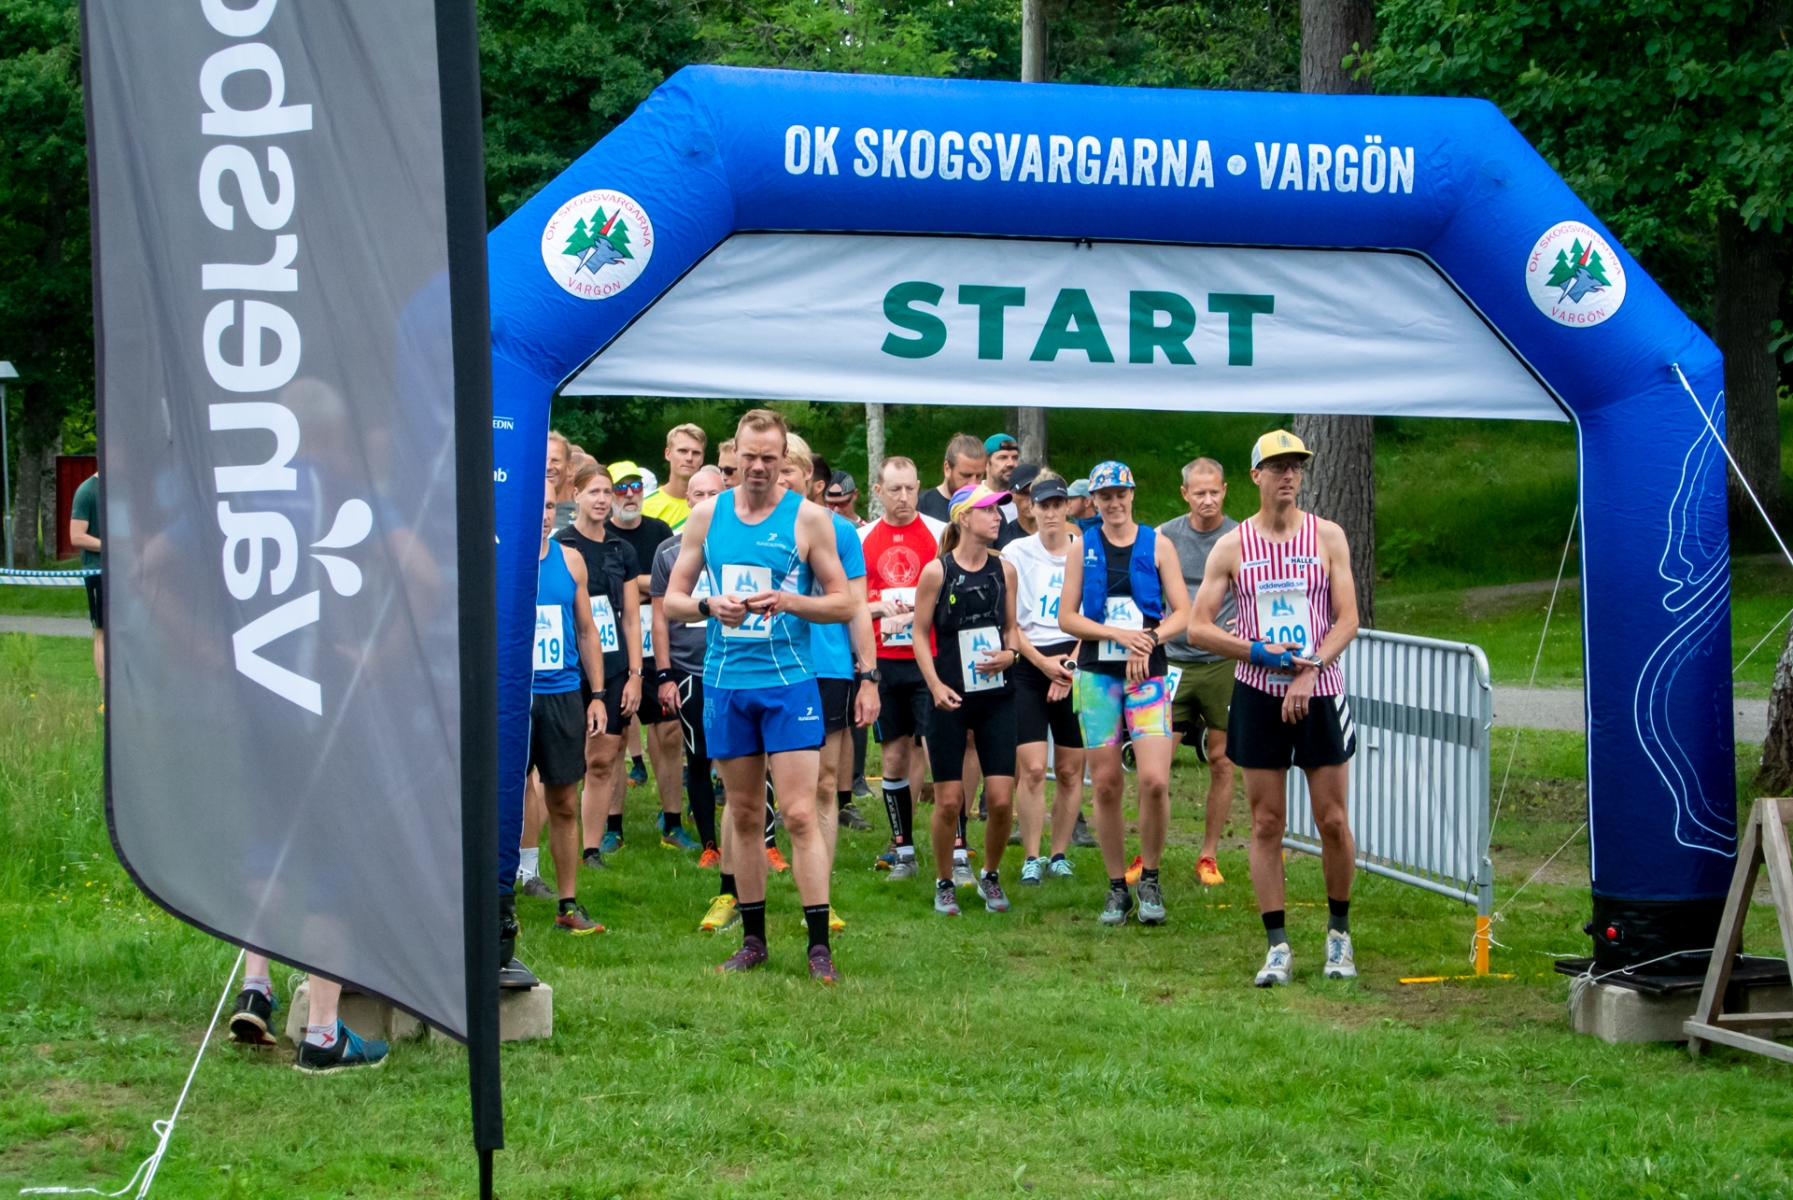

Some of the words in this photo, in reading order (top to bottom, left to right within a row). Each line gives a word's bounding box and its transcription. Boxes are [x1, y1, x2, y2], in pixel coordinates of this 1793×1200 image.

[785, 125, 839, 176] OK
[854, 127, 1214, 190] SKOGSVARGARNA
[1255, 134, 1415, 195] VARGÖN
[545, 220, 559, 241] OK
[558, 193, 651, 247] SKOGSVARGARNA
[1529, 251, 1542, 273] OK
[1539, 225, 1622, 275] SKOGSVARGARNA
[568, 277, 621, 296] VARGÖN
[881, 281, 1275, 366] START
[1551, 306, 1606, 324] VARGÖN
[1258, 581, 1304, 590] uddevalla.se
[1265, 624, 1307, 653] 109
